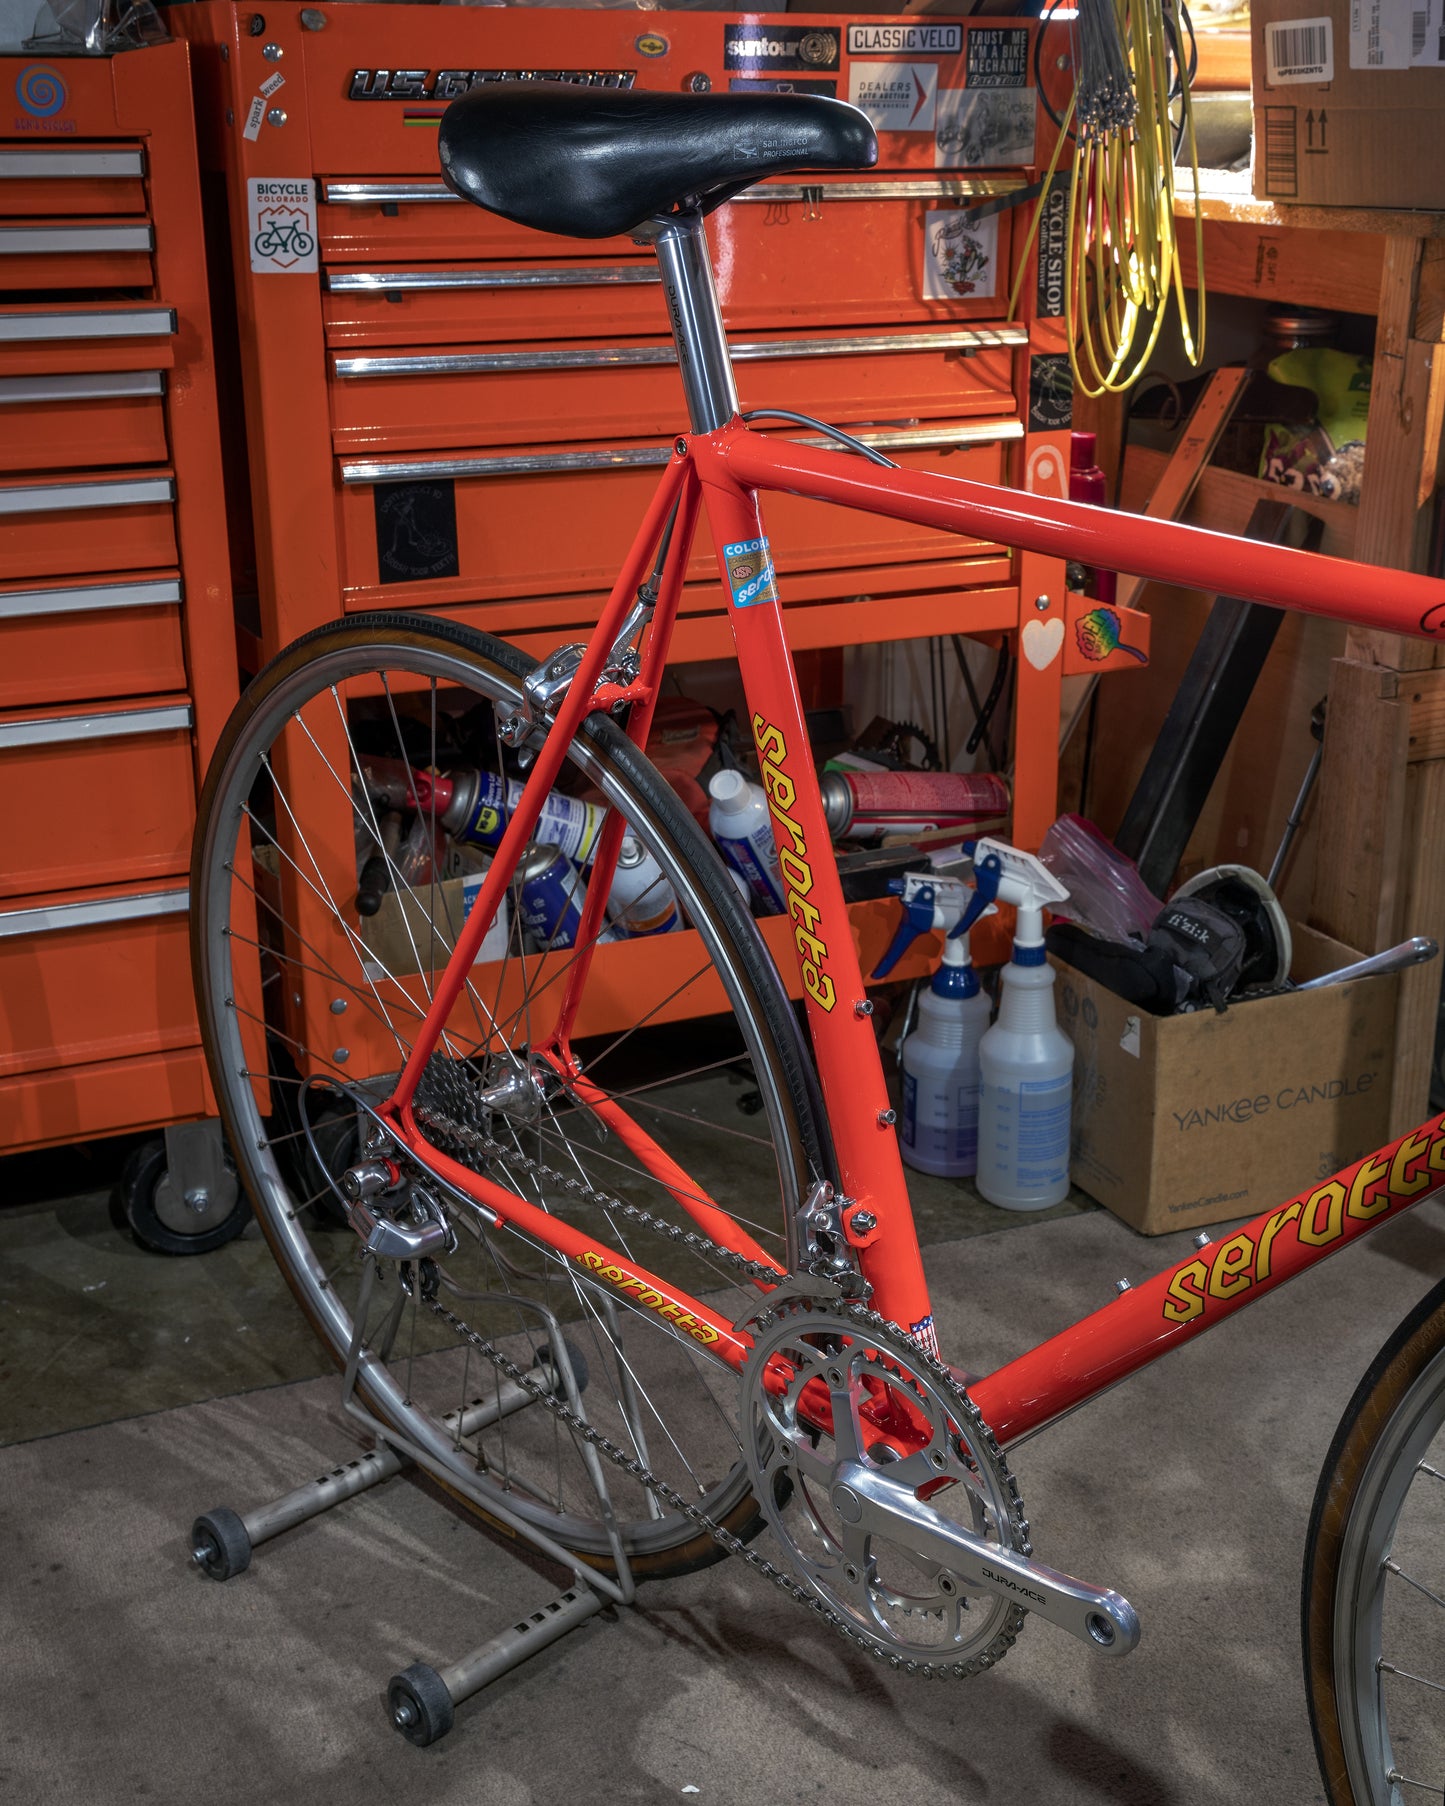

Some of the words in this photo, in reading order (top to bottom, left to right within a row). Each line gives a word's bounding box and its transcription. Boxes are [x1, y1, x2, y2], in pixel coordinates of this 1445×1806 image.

[728, 37, 798, 57] suntour
[854, 29, 916, 49] CLASSIC
[919, 29, 957, 49] VELO
[970, 31, 1004, 45] TRUST
[1011, 30, 1026, 44] ME
[970, 45, 988, 58] I'M
[991, 45, 998, 58] A
[1002, 44, 1026, 58] BIKE
[969, 58, 1025, 72] MECHANIC
[262, 74, 284, 96] weed
[859, 82, 912, 91] DEALERS
[879, 92, 911, 100] AUCTION
[250, 99, 264, 128] spark
[763, 149, 809, 158] PROFESSIONAL
[257, 184, 308, 195] BICYCLE
[257, 195, 309, 203] COLORADO
[1048, 189, 1065, 255] CYCLE
[1038, 254, 1048, 289] Denver
[1046, 258, 1063, 316] SHOP
[667, 285, 690, 365] DURA-ACE
[732, 565, 753, 579] USA
[752, 712, 837, 1014] serotta
[1168, 1188, 1250, 1215] YankeeCandle.com
[575, 1250, 720, 1345] serotta
[981, 1567, 1047, 1606] DURA-ACE
